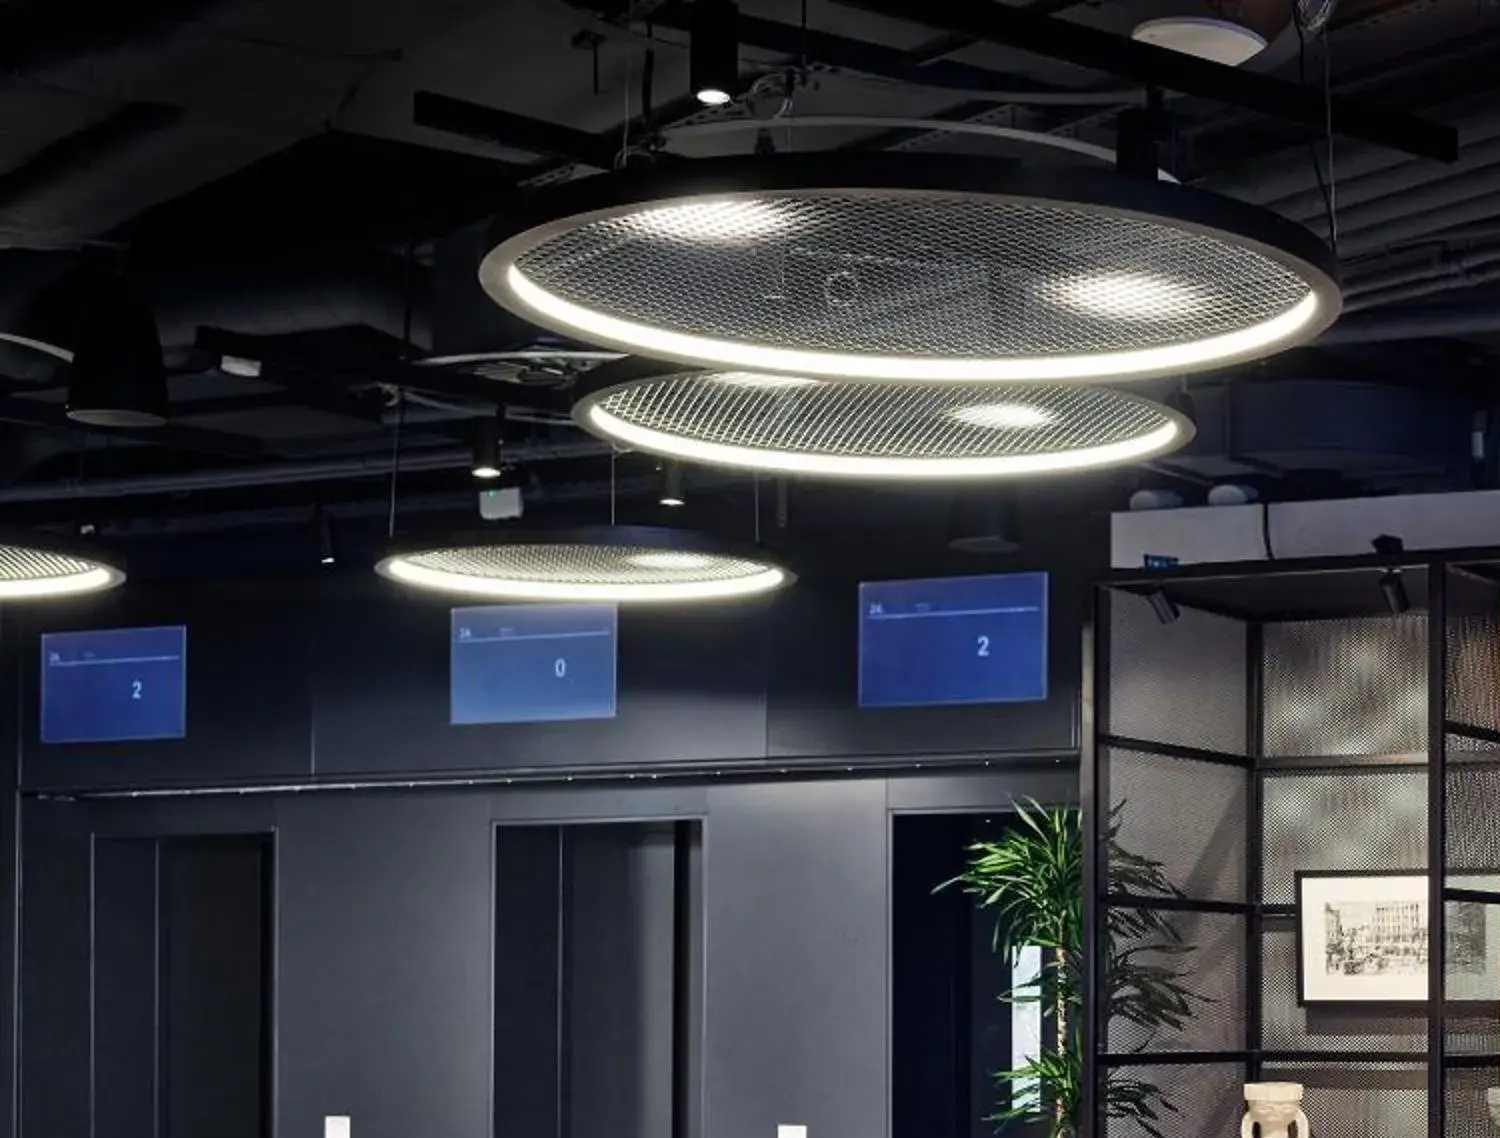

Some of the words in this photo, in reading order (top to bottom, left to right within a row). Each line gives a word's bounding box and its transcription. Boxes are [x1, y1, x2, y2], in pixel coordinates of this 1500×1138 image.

[977, 635, 989, 657] 2
[555, 658, 566, 678] 0
[132, 680, 142, 699] 2
